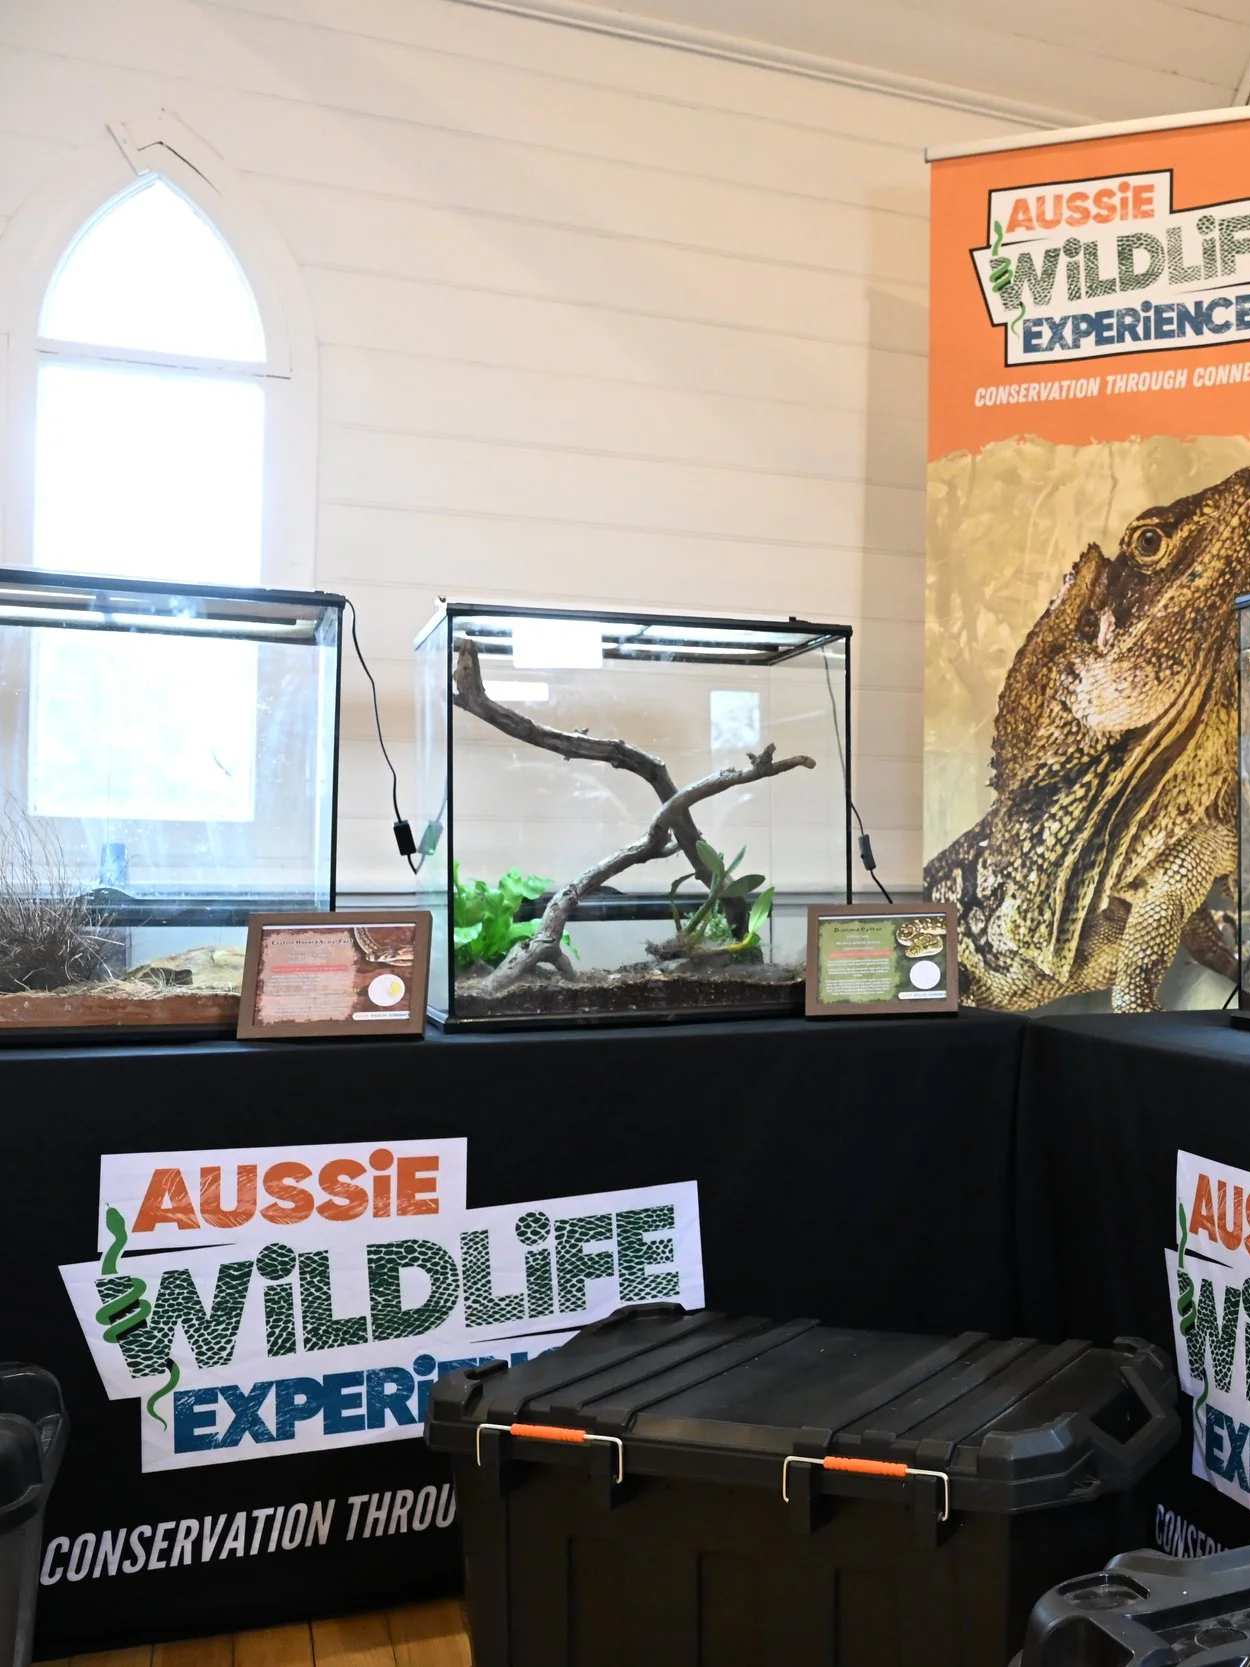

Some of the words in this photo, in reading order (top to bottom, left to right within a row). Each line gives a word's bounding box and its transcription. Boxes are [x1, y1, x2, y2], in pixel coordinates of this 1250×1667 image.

[974, 377, 1100, 408] CONSERVATION
[1105, 368, 1188, 395] THROUGH
[39, 1498, 336, 1586] CONSERVATION
[345, 1483, 457, 1541] THROU
